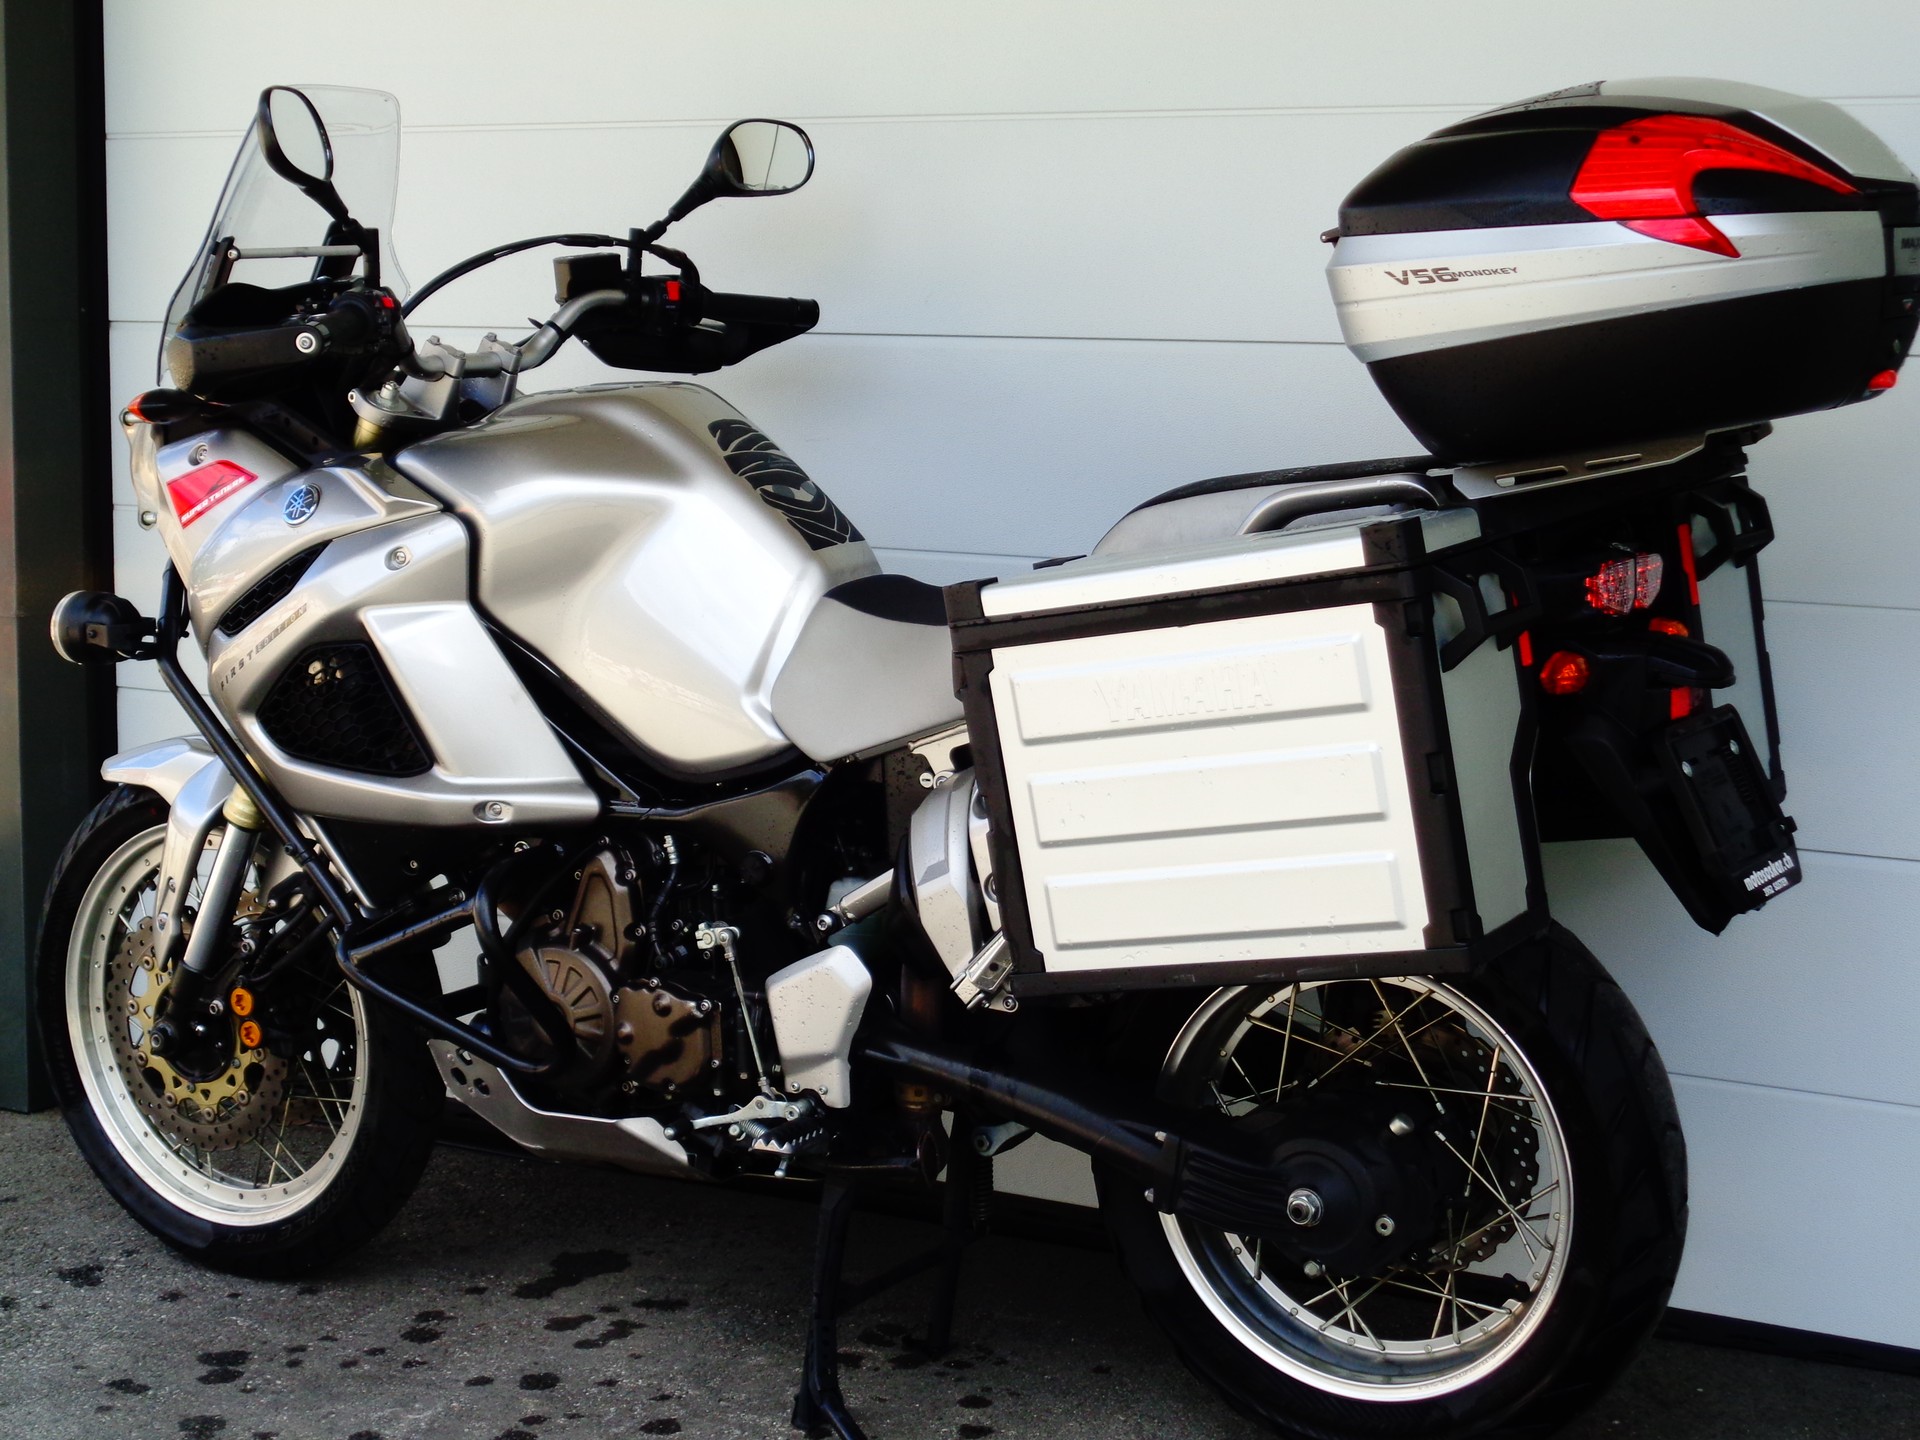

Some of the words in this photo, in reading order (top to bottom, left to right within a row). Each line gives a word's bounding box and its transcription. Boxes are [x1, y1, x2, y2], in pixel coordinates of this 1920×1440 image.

[1384, 267, 1459, 286] V56
[1452, 267, 1518, 279] MONOKEY
[181, 498, 209, 523] SUPER
[220, 649, 254, 691] FIRST
[255, 603, 307, 655] EDITION
[1093, 658, 1274, 723] YAMAHA
